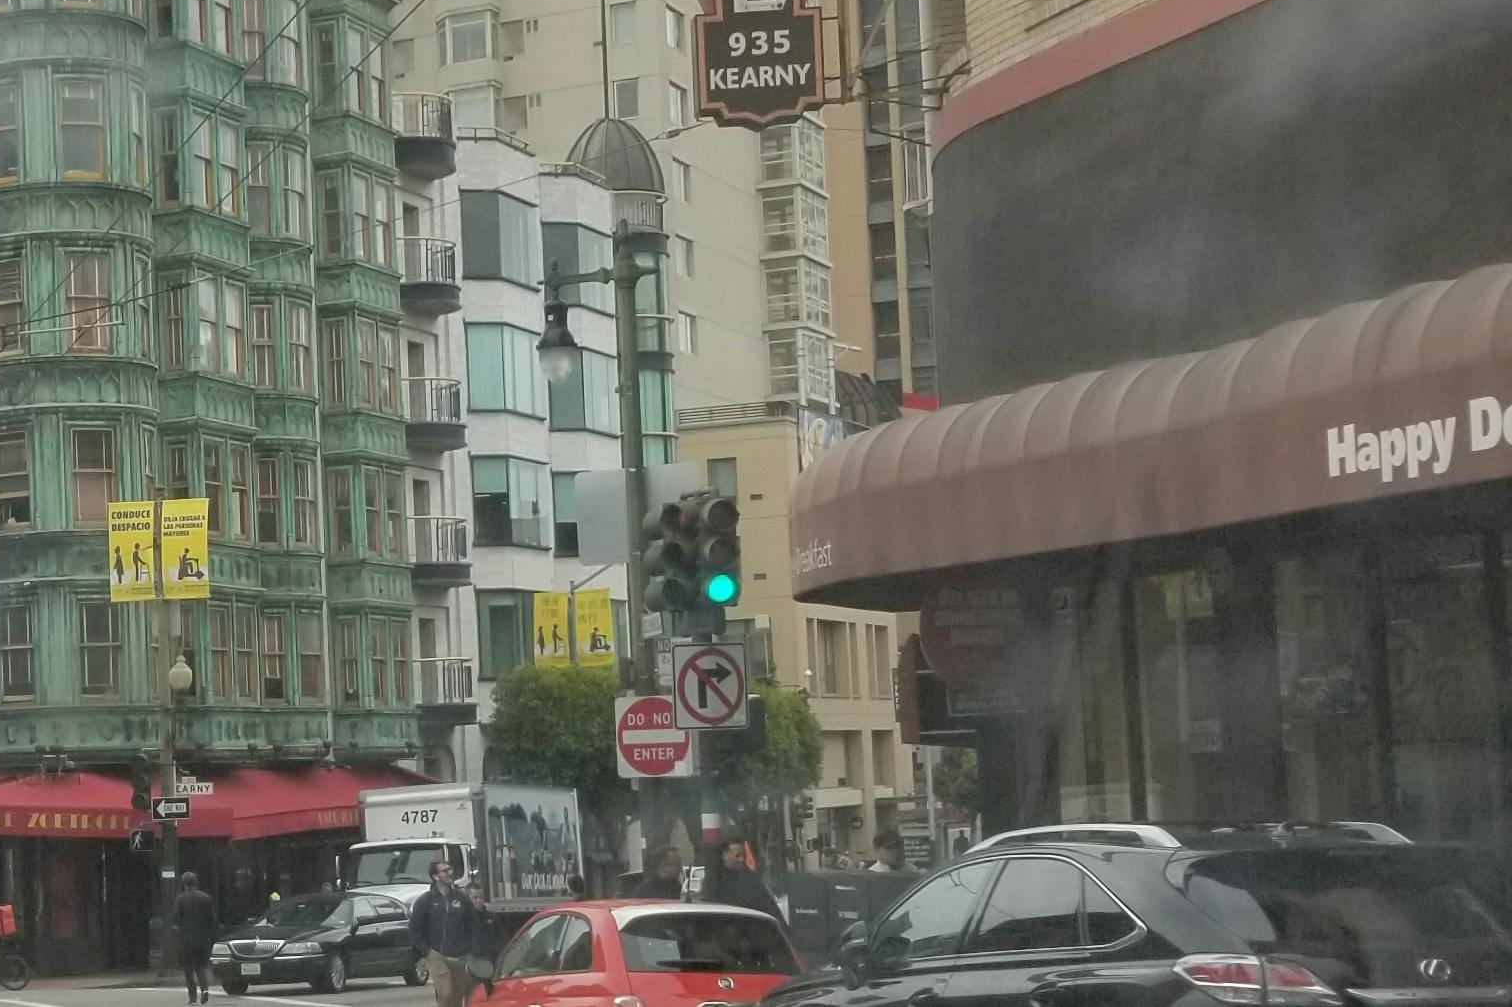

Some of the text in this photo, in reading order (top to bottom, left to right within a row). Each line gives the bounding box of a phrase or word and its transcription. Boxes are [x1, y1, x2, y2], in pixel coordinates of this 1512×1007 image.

[728, 29, 791, 57] 935
[709, 63, 812, 90] KEARNY
[1327, 416, 1456, 483] Happy
[111, 510, 150, 520] CONDUCE
[111, 522, 150, 531] DESPACIO
[627, 712, 672, 726] DO NO
[633, 748, 674, 761] ENTER
[175, 784, 210, 793] EARNY
[401, 809, 438, 824] 4787
